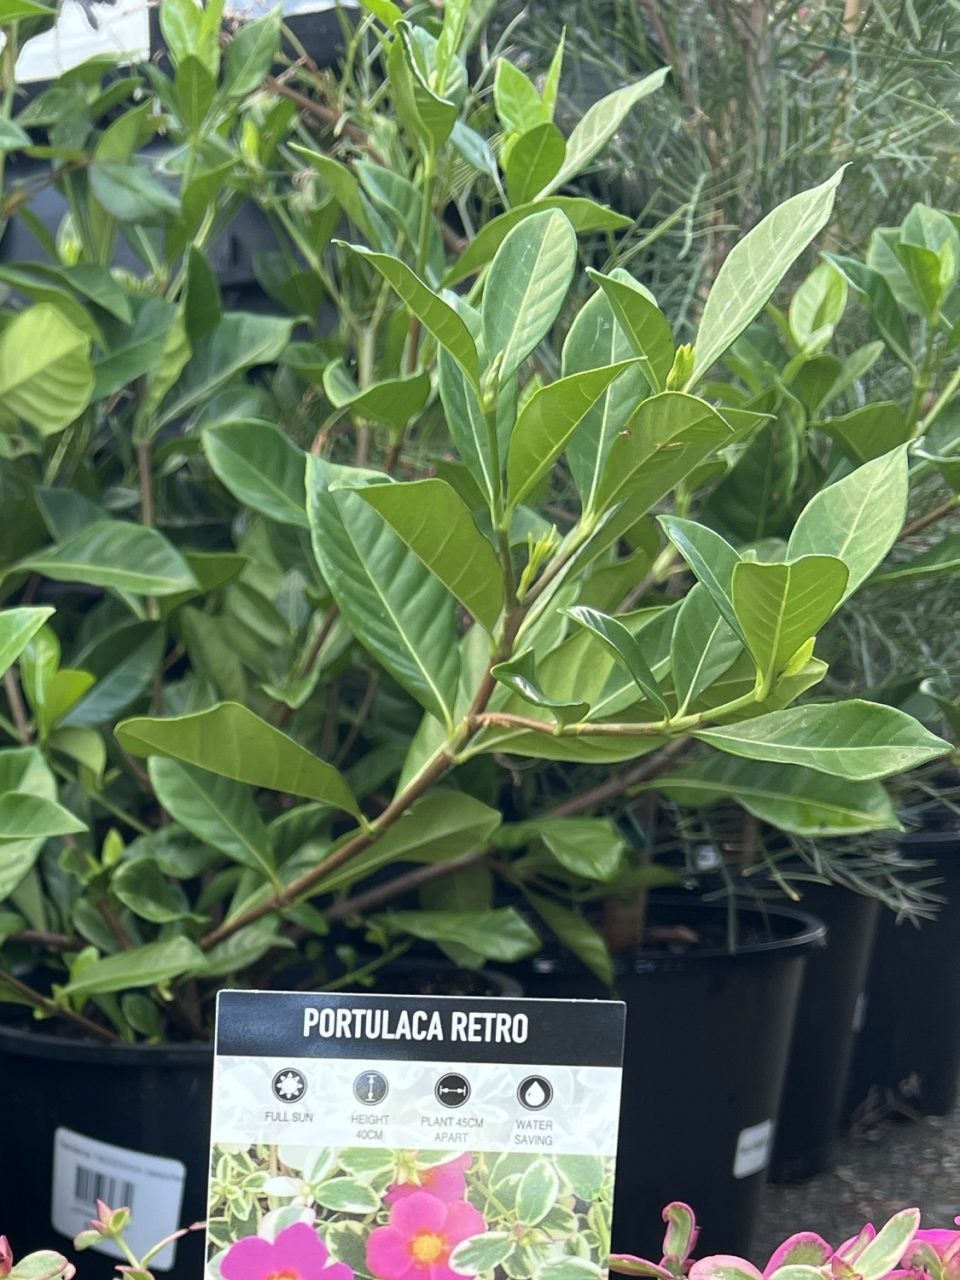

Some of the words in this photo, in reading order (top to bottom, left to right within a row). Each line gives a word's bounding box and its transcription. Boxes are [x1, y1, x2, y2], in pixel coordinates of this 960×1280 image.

[303, 1007, 444, 1042] PORTULACA
[451, 1011, 529, 1044] RETRO
[265, 1111, 290, 1123] FULL
[292, 1112, 314, 1124] SUN
[351, 1113, 389, 1126] HEIGHT
[420, 1116, 455, 1128] PLANT
[457, 1116, 484, 1129] 45CM
[515, 1119, 553, 1131] WATER
[355, 1129, 383, 1141] 40CM
[434, 1131, 468, 1144] APART
[514, 1134, 553, 1147] SAVING
